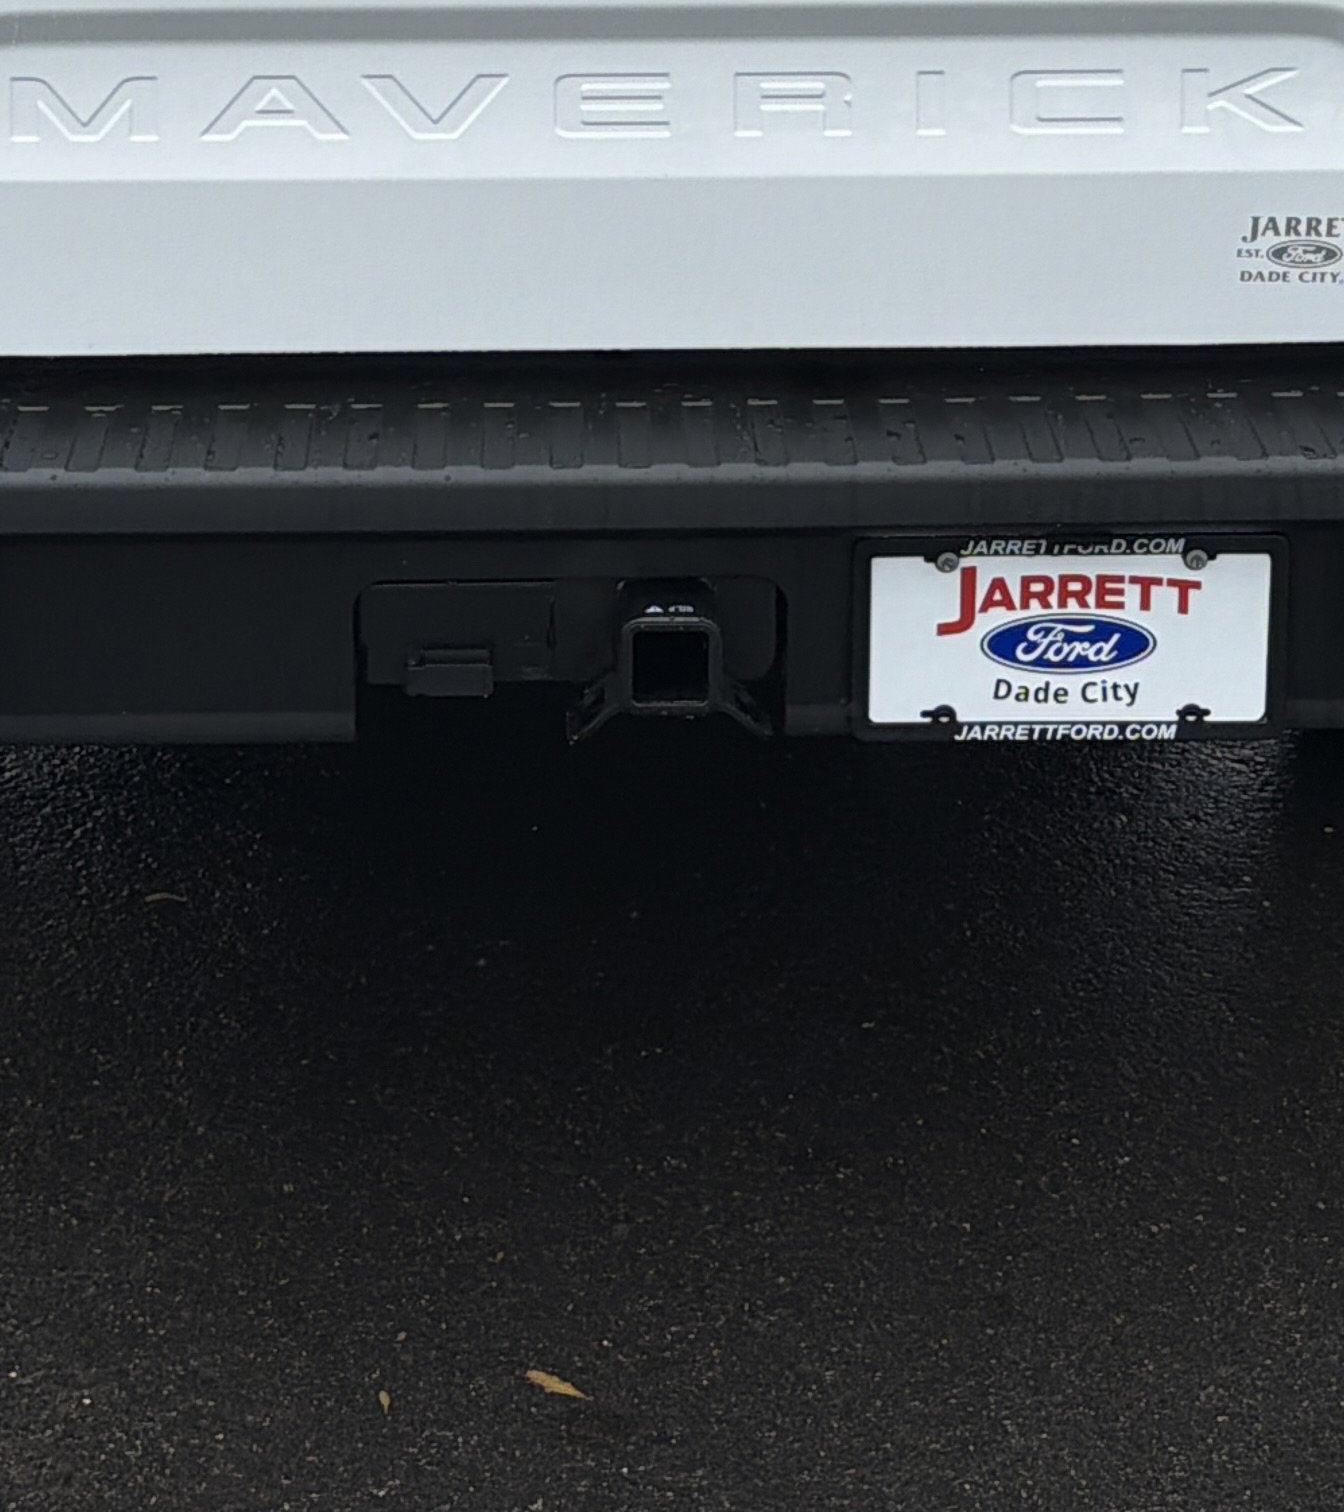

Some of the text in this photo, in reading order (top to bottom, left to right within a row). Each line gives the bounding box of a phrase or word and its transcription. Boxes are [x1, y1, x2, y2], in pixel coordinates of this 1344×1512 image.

[9, 66, 1306, 144] MAVERICK
[1236, 247, 1264, 259] EST.
[1281, 245, 1328, 263] Ford
[1239, 269, 1291, 283] DADE
[937, 565, 1202, 636] JARRETT
[1015, 622, 1122, 663] Ford
[992, 678, 1141, 707] Dade City
[953, 723, 1178, 742] JARRETTFORD.COM
